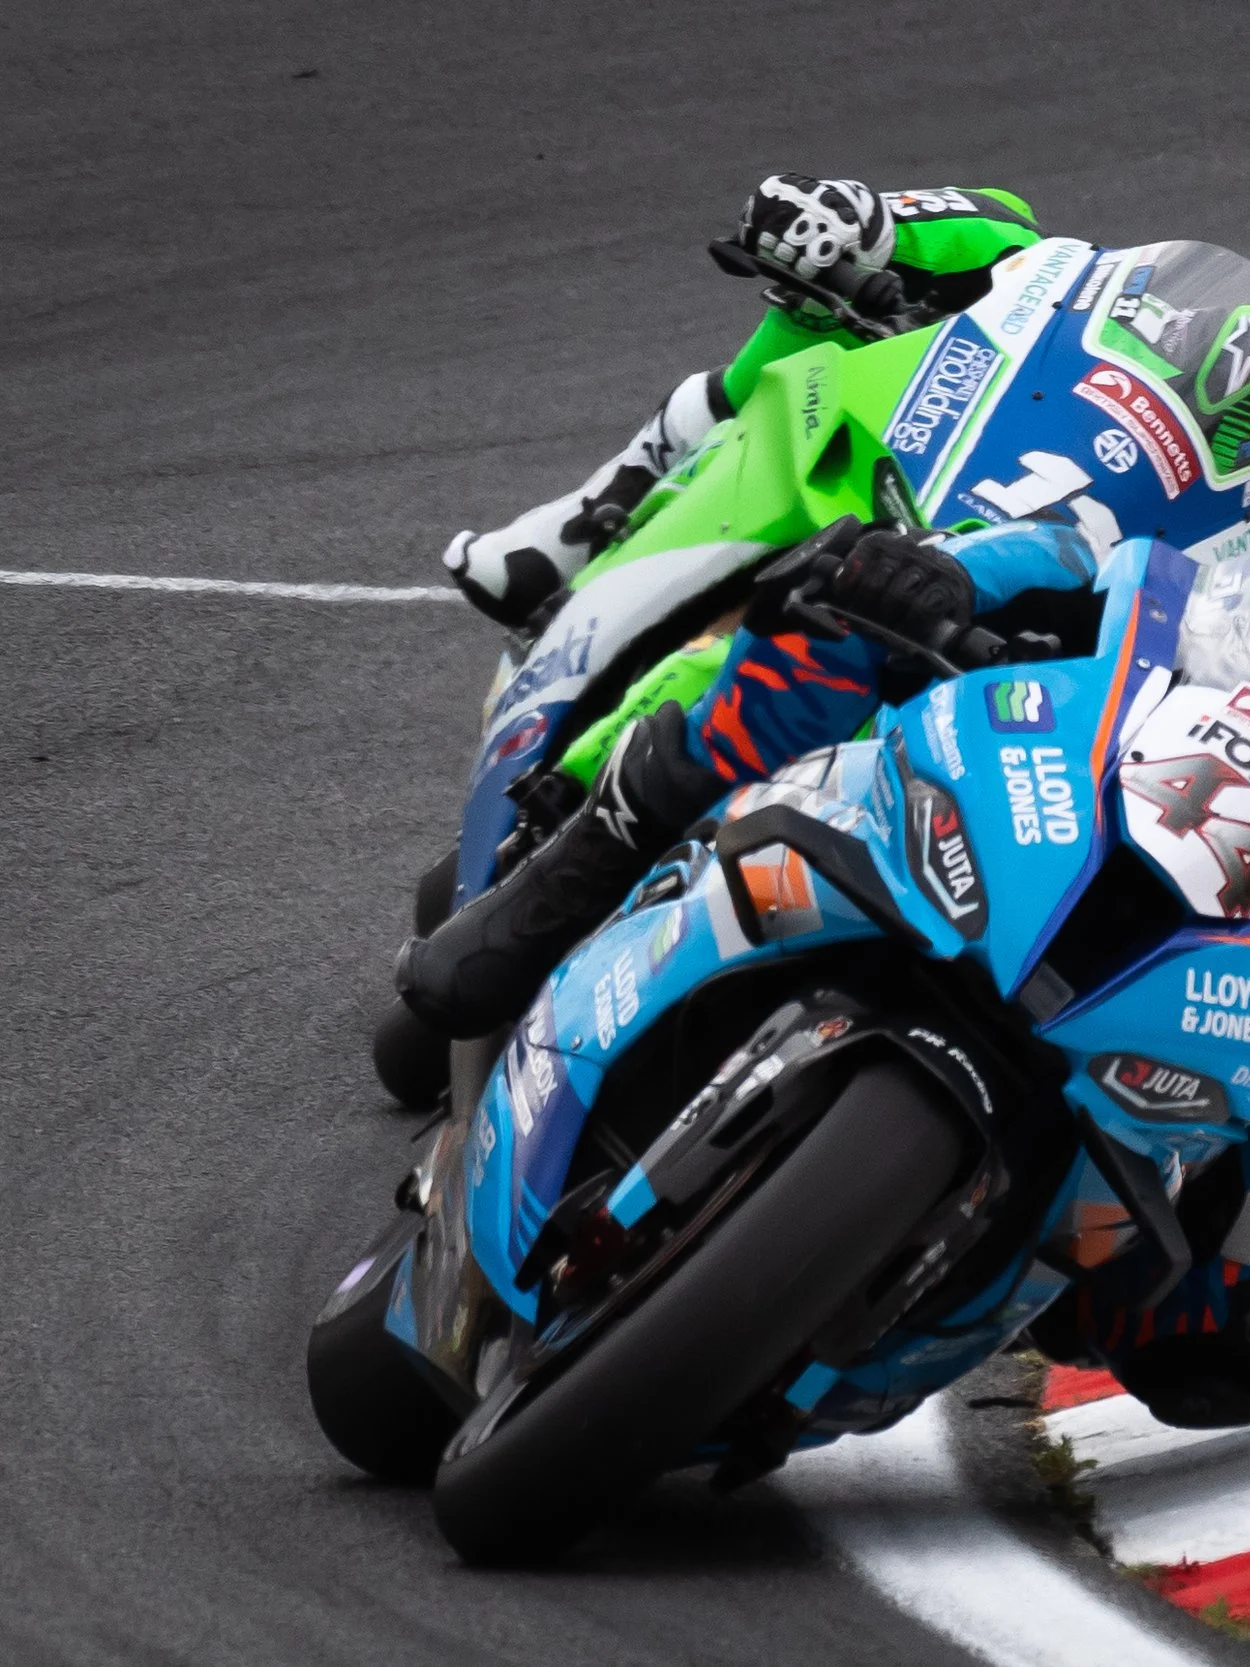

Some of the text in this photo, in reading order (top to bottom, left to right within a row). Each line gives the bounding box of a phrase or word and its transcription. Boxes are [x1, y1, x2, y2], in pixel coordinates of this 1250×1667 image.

[1018, 244, 1082, 306] VANTAGE
[807, 365, 825, 441] Ninja
[893, 337, 981, 455] mouldings
[1129, 396, 1192, 482] Bennetts
[1004, 766, 1042, 847] JONES
[1032, 746, 1079, 845] LLOYD
